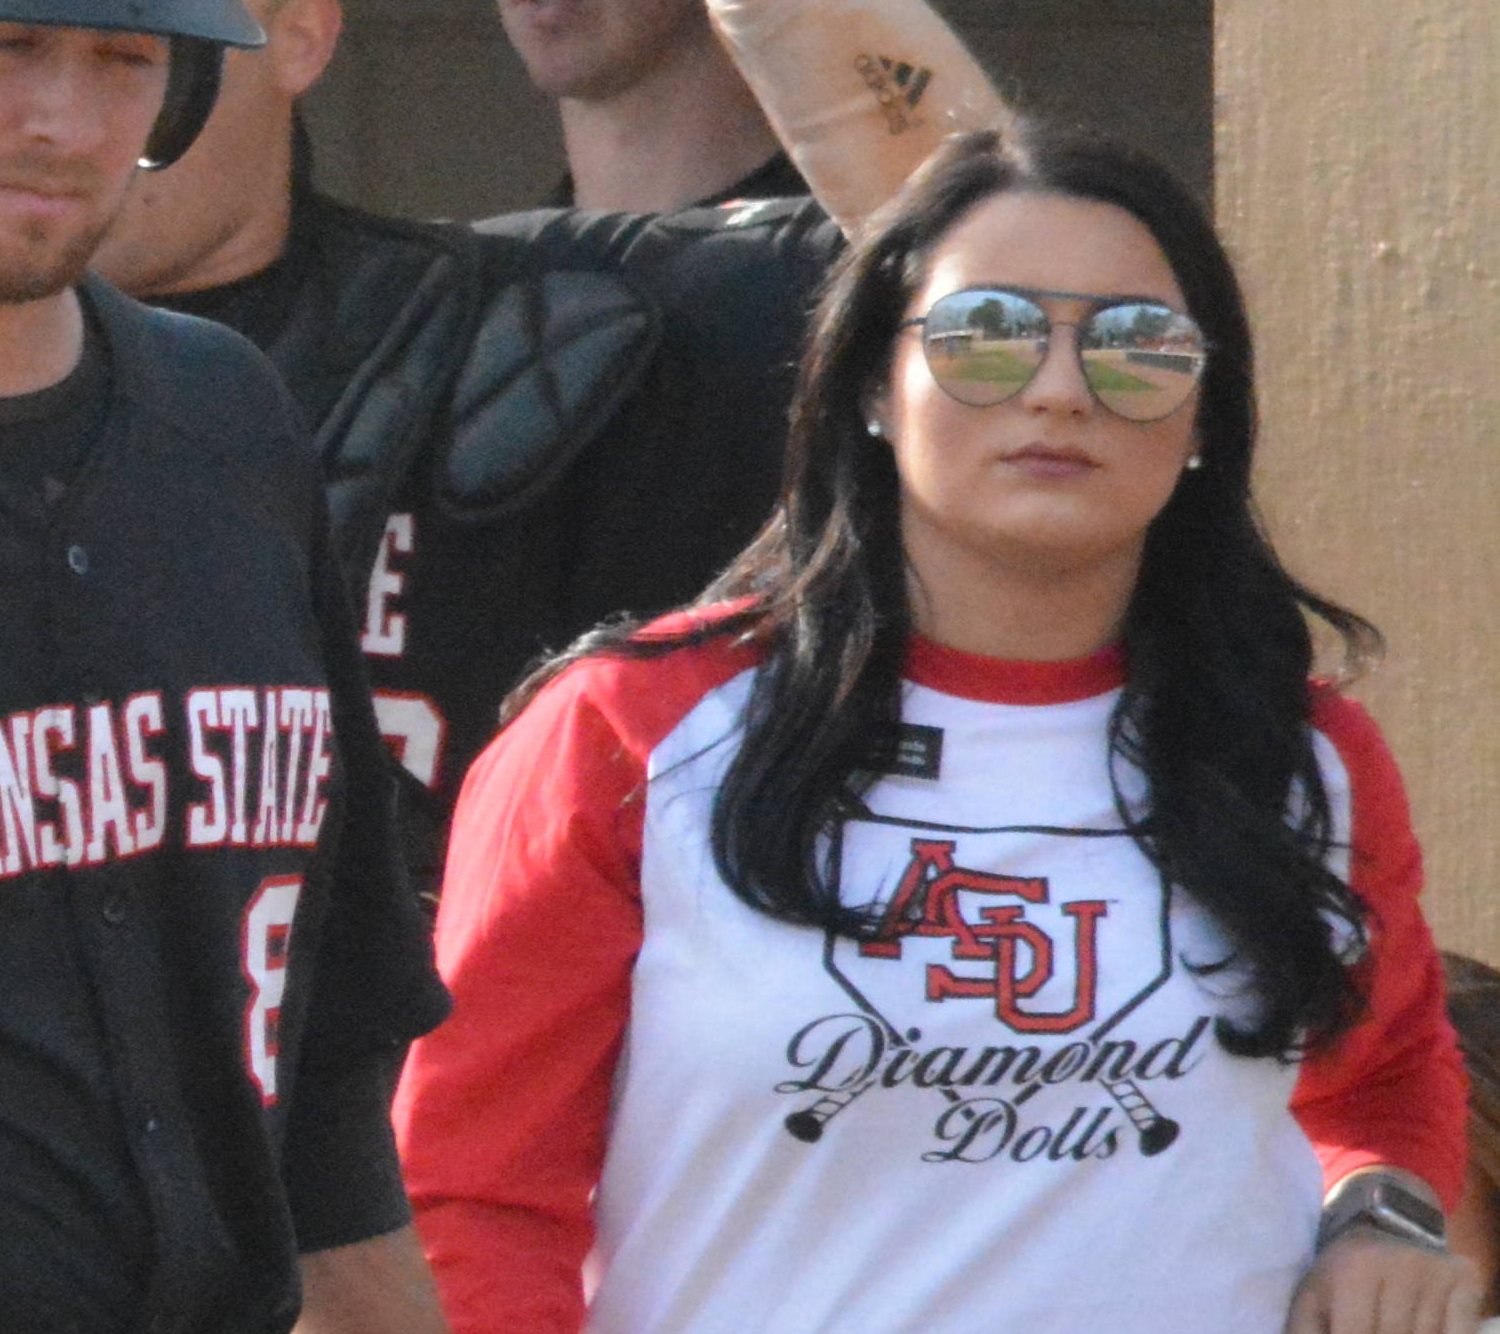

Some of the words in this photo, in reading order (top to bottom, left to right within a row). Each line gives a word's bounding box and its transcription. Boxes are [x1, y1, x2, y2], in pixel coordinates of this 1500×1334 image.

[185, 685, 332, 849] STATE
[859, 838, 1109, 1035] ASU
[774, 1013, 1212, 1095] Diamond
[920, 1097, 1128, 1165] Dolls
